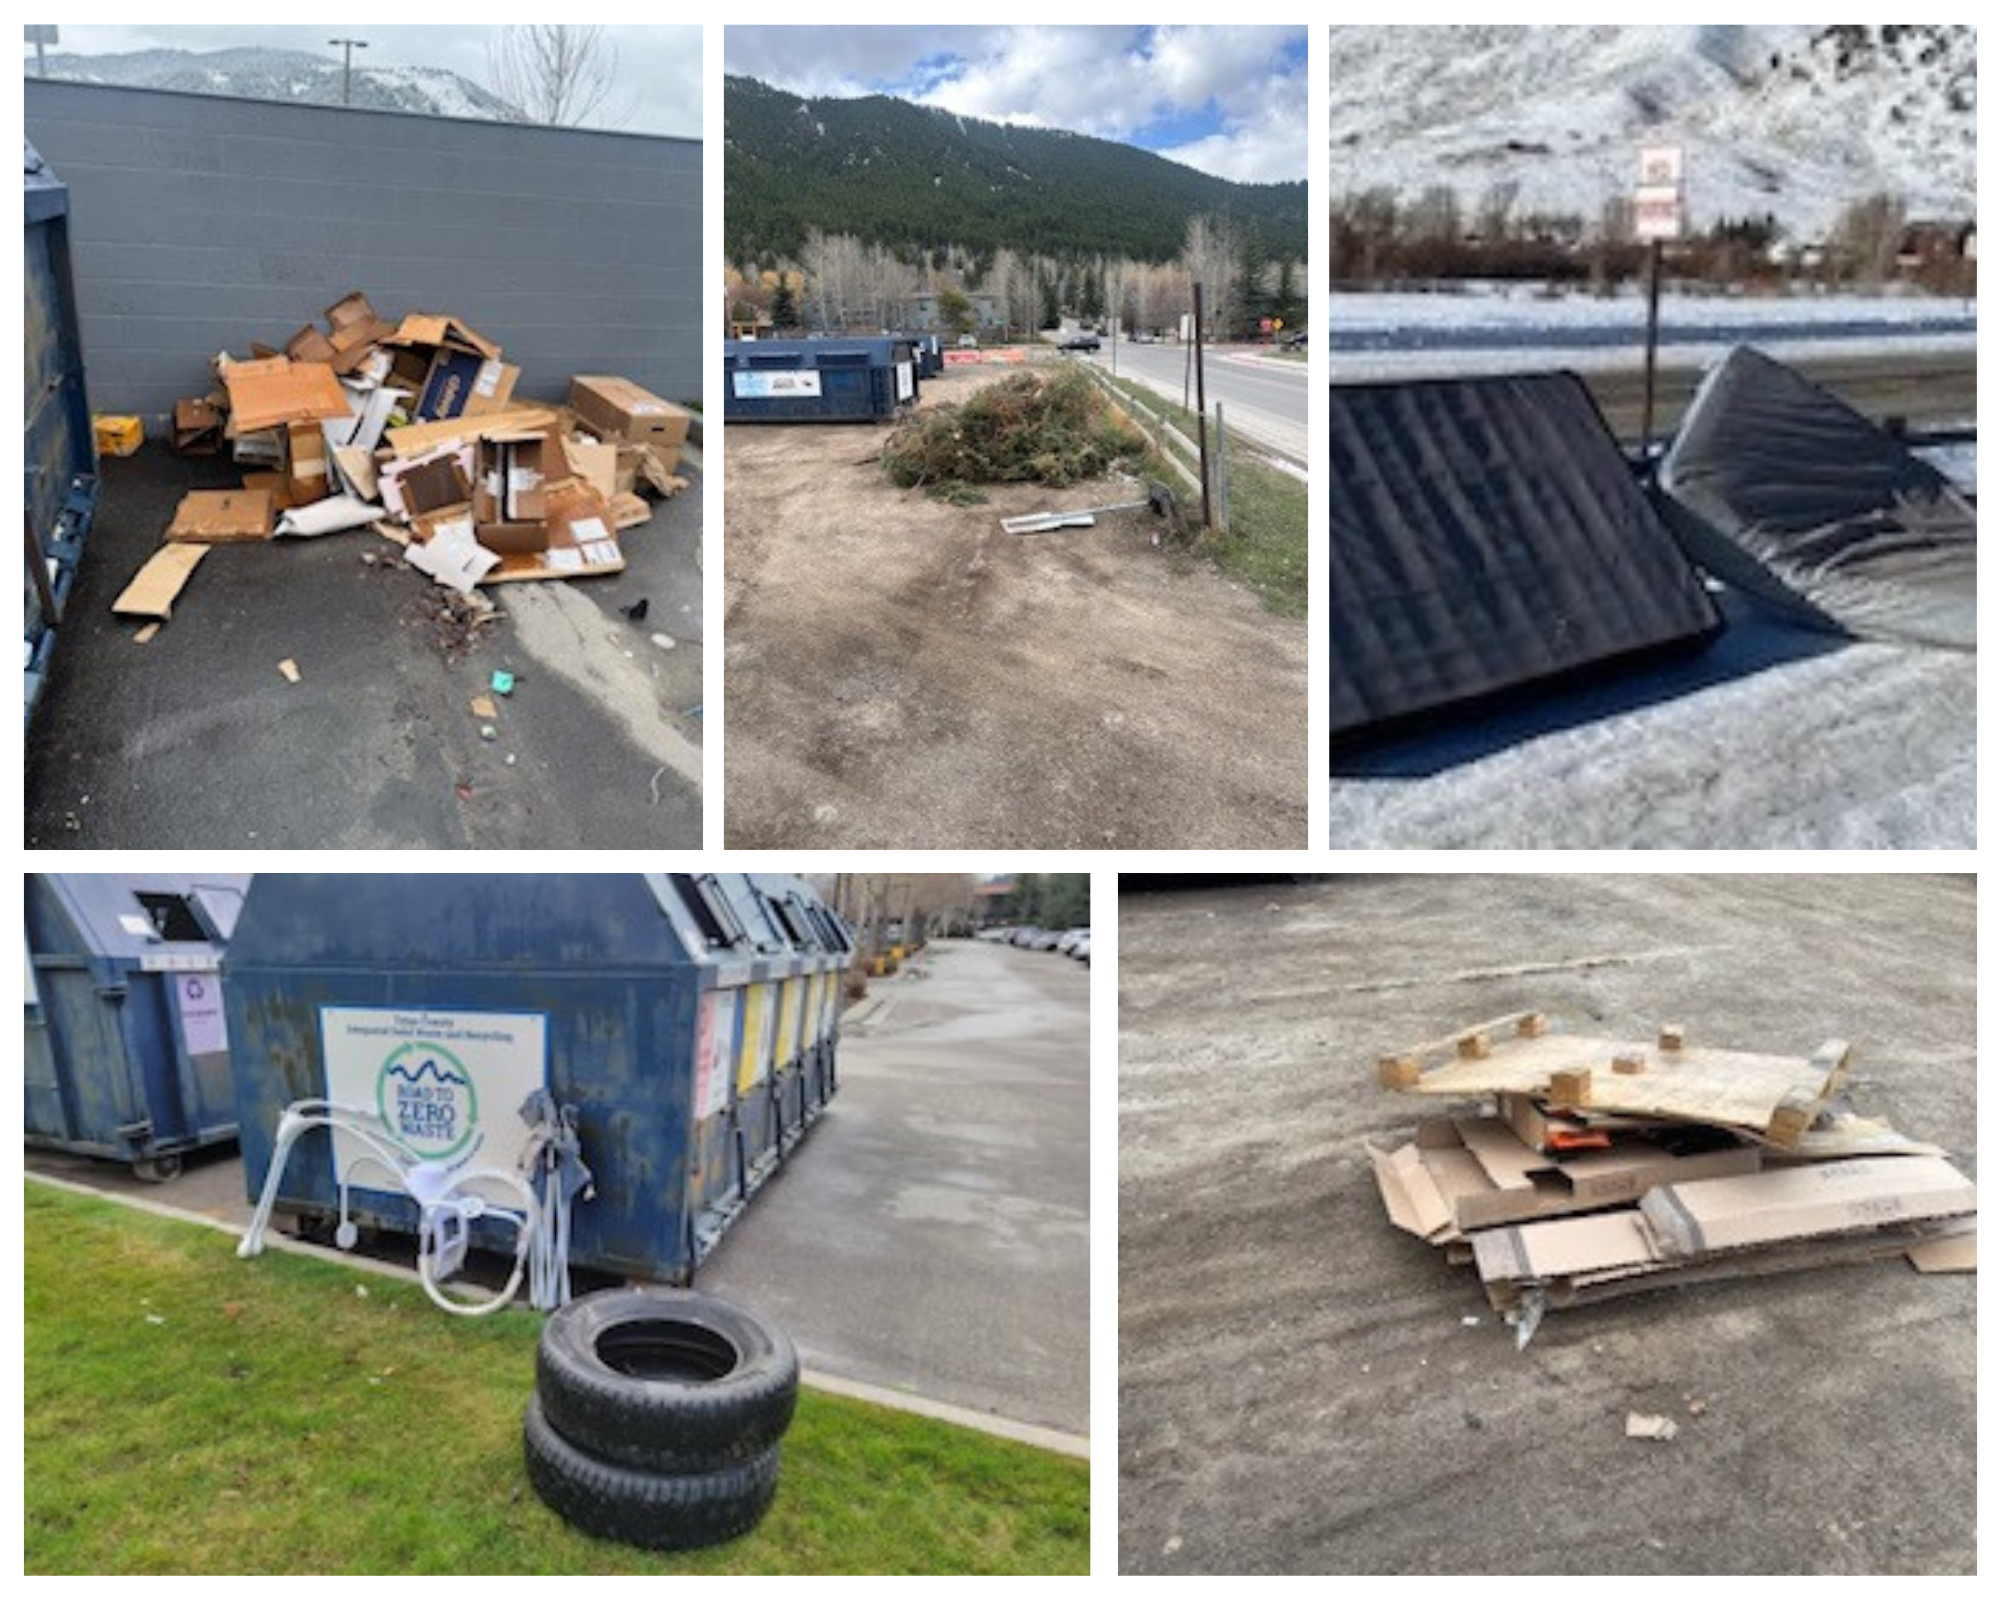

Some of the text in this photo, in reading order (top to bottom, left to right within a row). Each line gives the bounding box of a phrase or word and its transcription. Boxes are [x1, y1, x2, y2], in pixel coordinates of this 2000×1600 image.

[396, 1085, 455, 1102] ROAD TO
[397, 1101, 456, 1122] ZERO
[400, 1121, 455, 1141] WASTE
